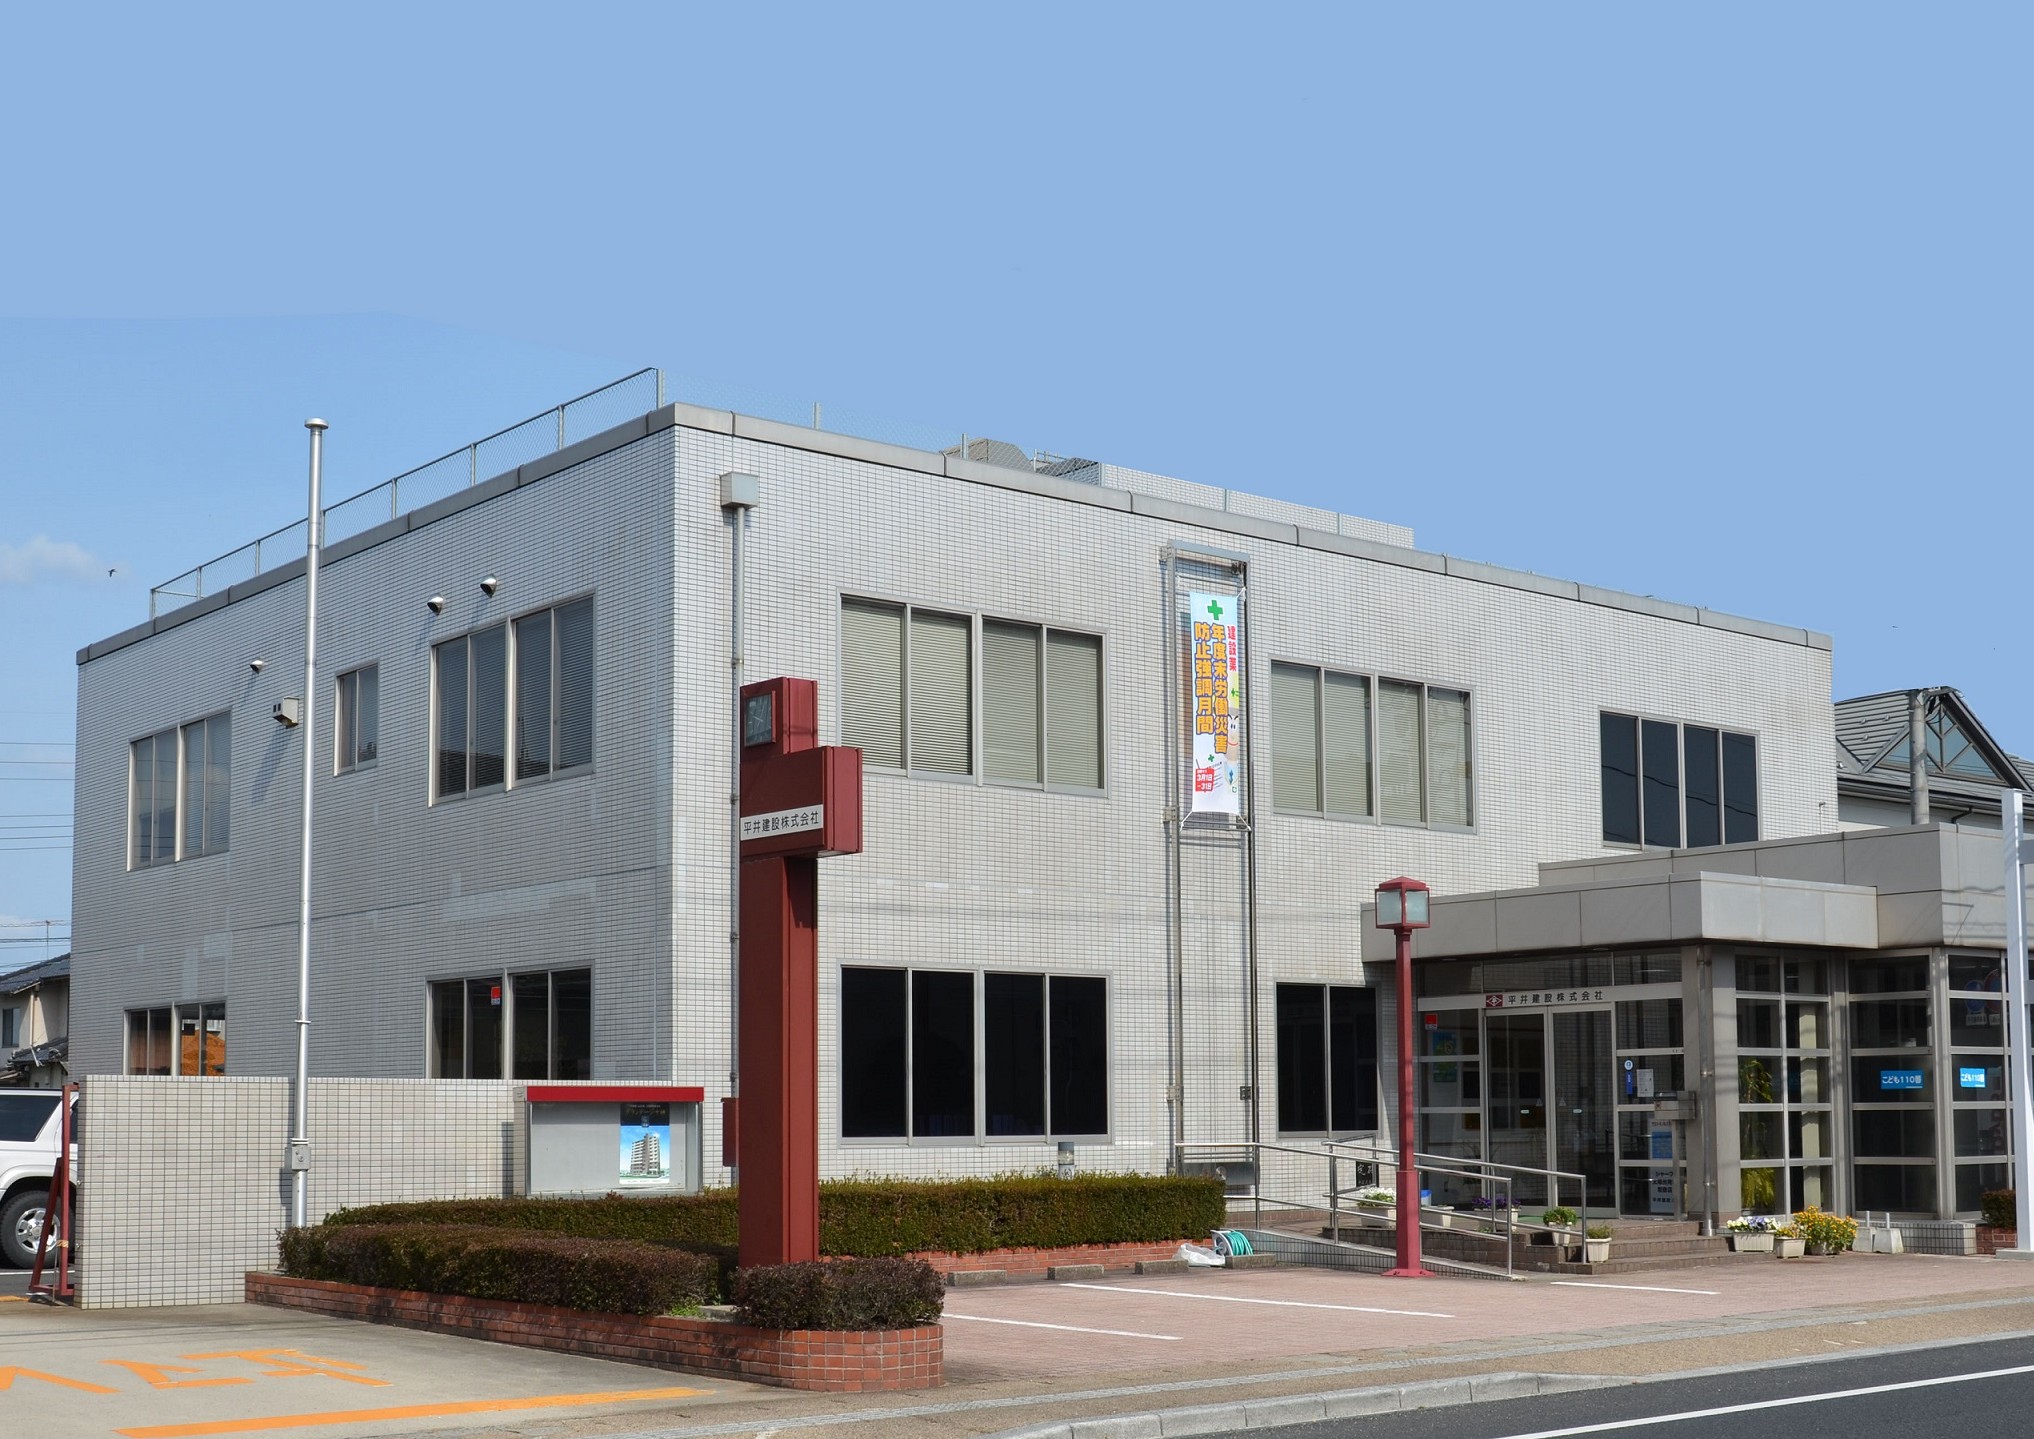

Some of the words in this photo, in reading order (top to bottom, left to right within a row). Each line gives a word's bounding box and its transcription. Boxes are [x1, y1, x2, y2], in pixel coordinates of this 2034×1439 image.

[1227, 625, 1237, 671] 建設業
[1194, 621, 1214, 735] 防止強調月間
[1211, 623, 1229, 754] 年度末労働災害
[743, 811, 819, 835] 平井建設株式会社
[1508, 990, 1603, 1005] 平井建設株式会社
[1882, 1075, 1921, 1084] こども110番
